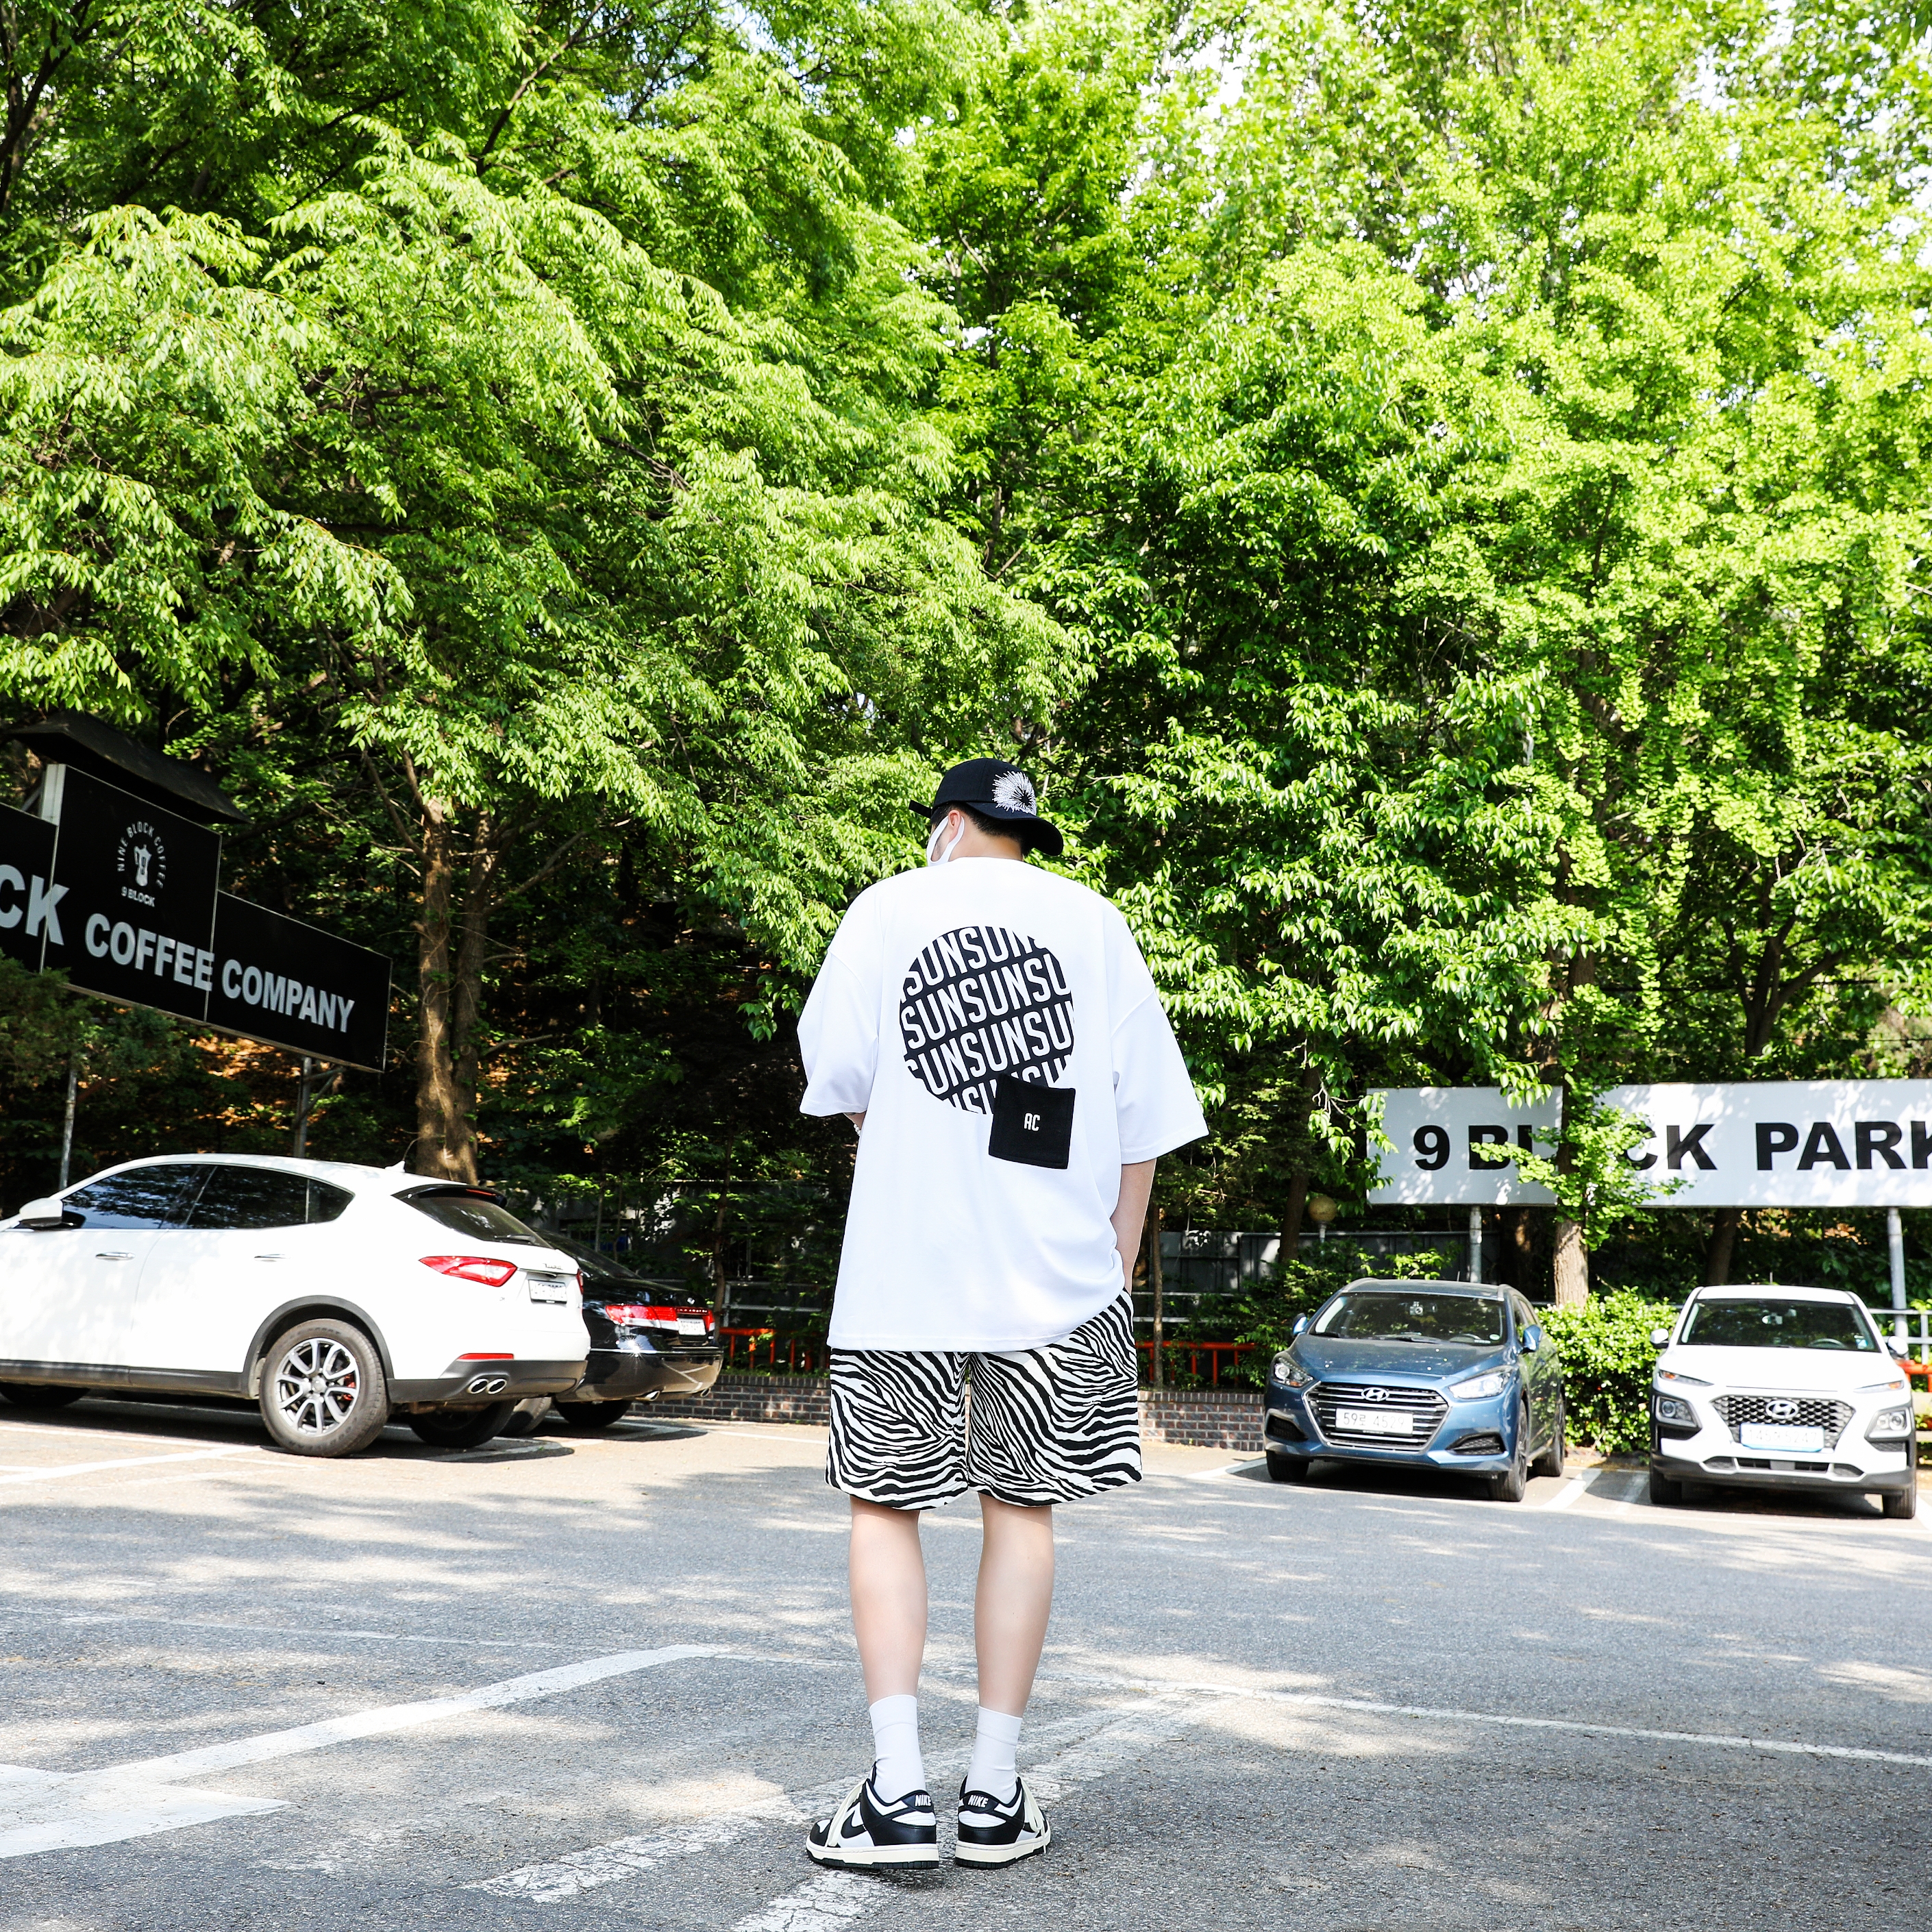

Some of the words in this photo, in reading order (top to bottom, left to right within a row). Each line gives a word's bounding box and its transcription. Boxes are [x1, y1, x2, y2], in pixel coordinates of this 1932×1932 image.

[116, 837, 128, 871] NINE
[126, 821, 155, 838] BLOCK
[153, 836, 166, 889] COFFEE
[121, 886, 127, 897] 9
[127, 888, 156, 907] BLOCK
[85, 913, 215, 992] COFFEE
[221, 959, 356, 1033] COMPANY
[1024, 1113, 1041, 1131] AC
[1413, 1124, 1450, 1171] 9
[1343, 1412, 1366, 1426] 59로
[1373, 1415, 1405, 1430] 4529
[1785, 1431, 1817, 1444] 5247
[915, 1794, 932, 1807] NIKE
[967, 1794, 989, 1808] NIKE
